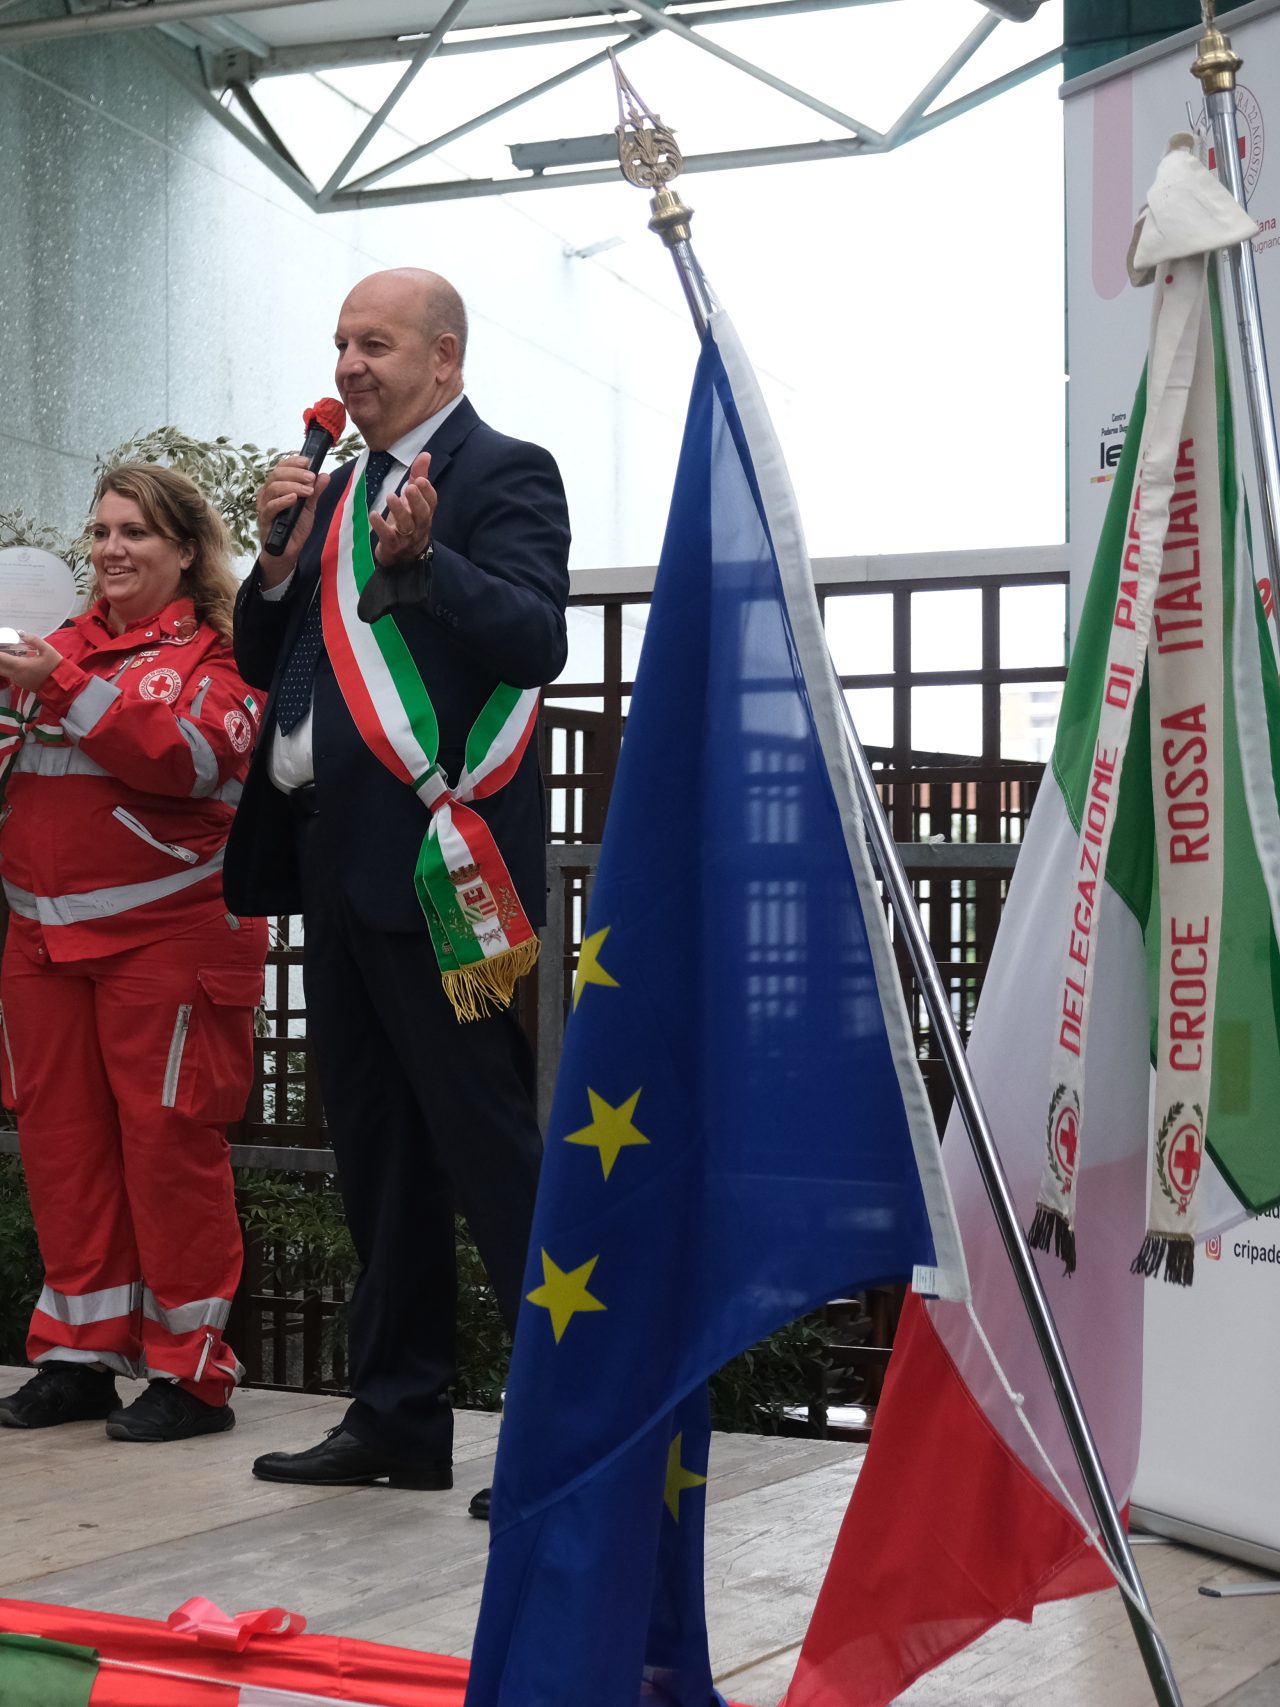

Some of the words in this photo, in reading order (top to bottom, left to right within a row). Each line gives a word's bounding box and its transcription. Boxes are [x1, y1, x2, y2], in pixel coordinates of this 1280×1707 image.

[1059, 739, 1119, 1057] DELEGAZIONE
[1105, 663, 1135, 710] DI
[1160, 703, 1210, 865] ROSSA
[1168, 914, 1210, 1072] CROCE
